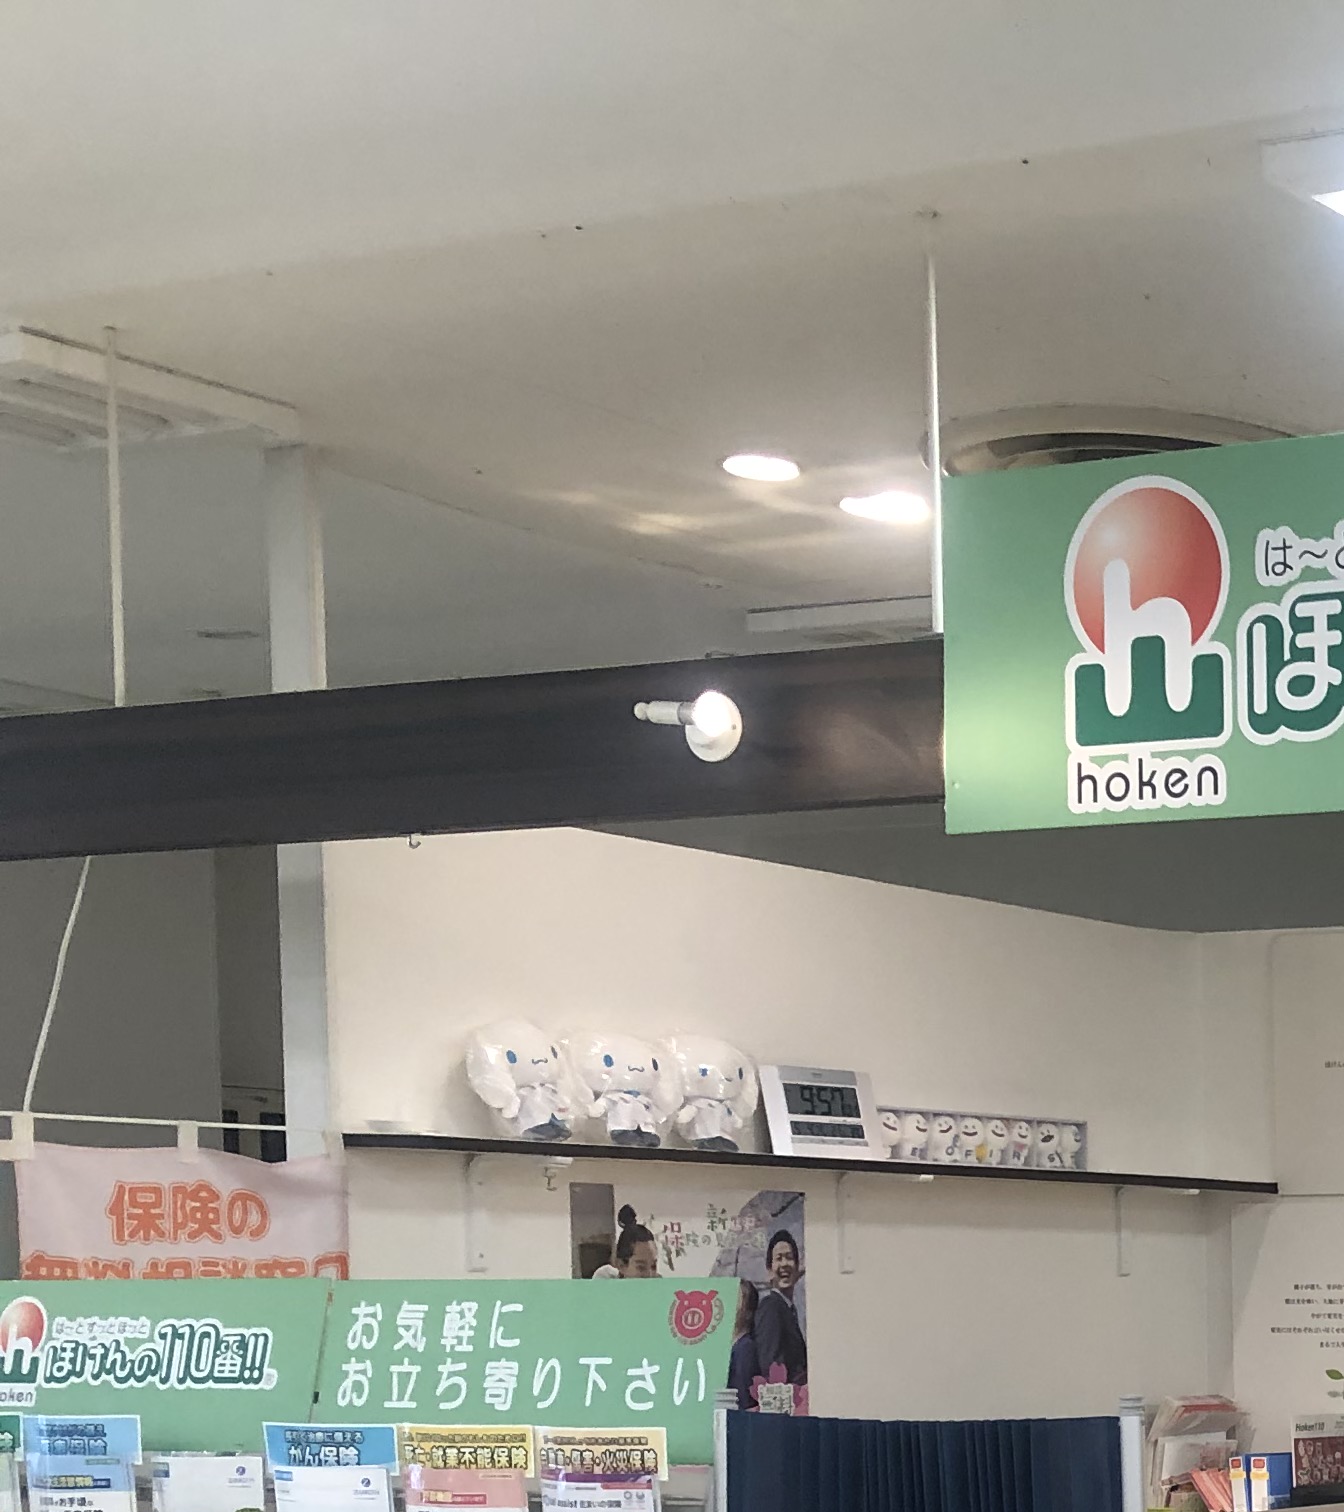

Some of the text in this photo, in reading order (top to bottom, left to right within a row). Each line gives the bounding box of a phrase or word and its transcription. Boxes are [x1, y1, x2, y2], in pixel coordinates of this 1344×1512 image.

[1075, 759, 1222, 804] hoken
[105, 1180, 271, 1245] 保険の
[346, 1299, 525, 1352] お気軽に
[336, 1358, 707, 1412] お立ち寄り下さい
